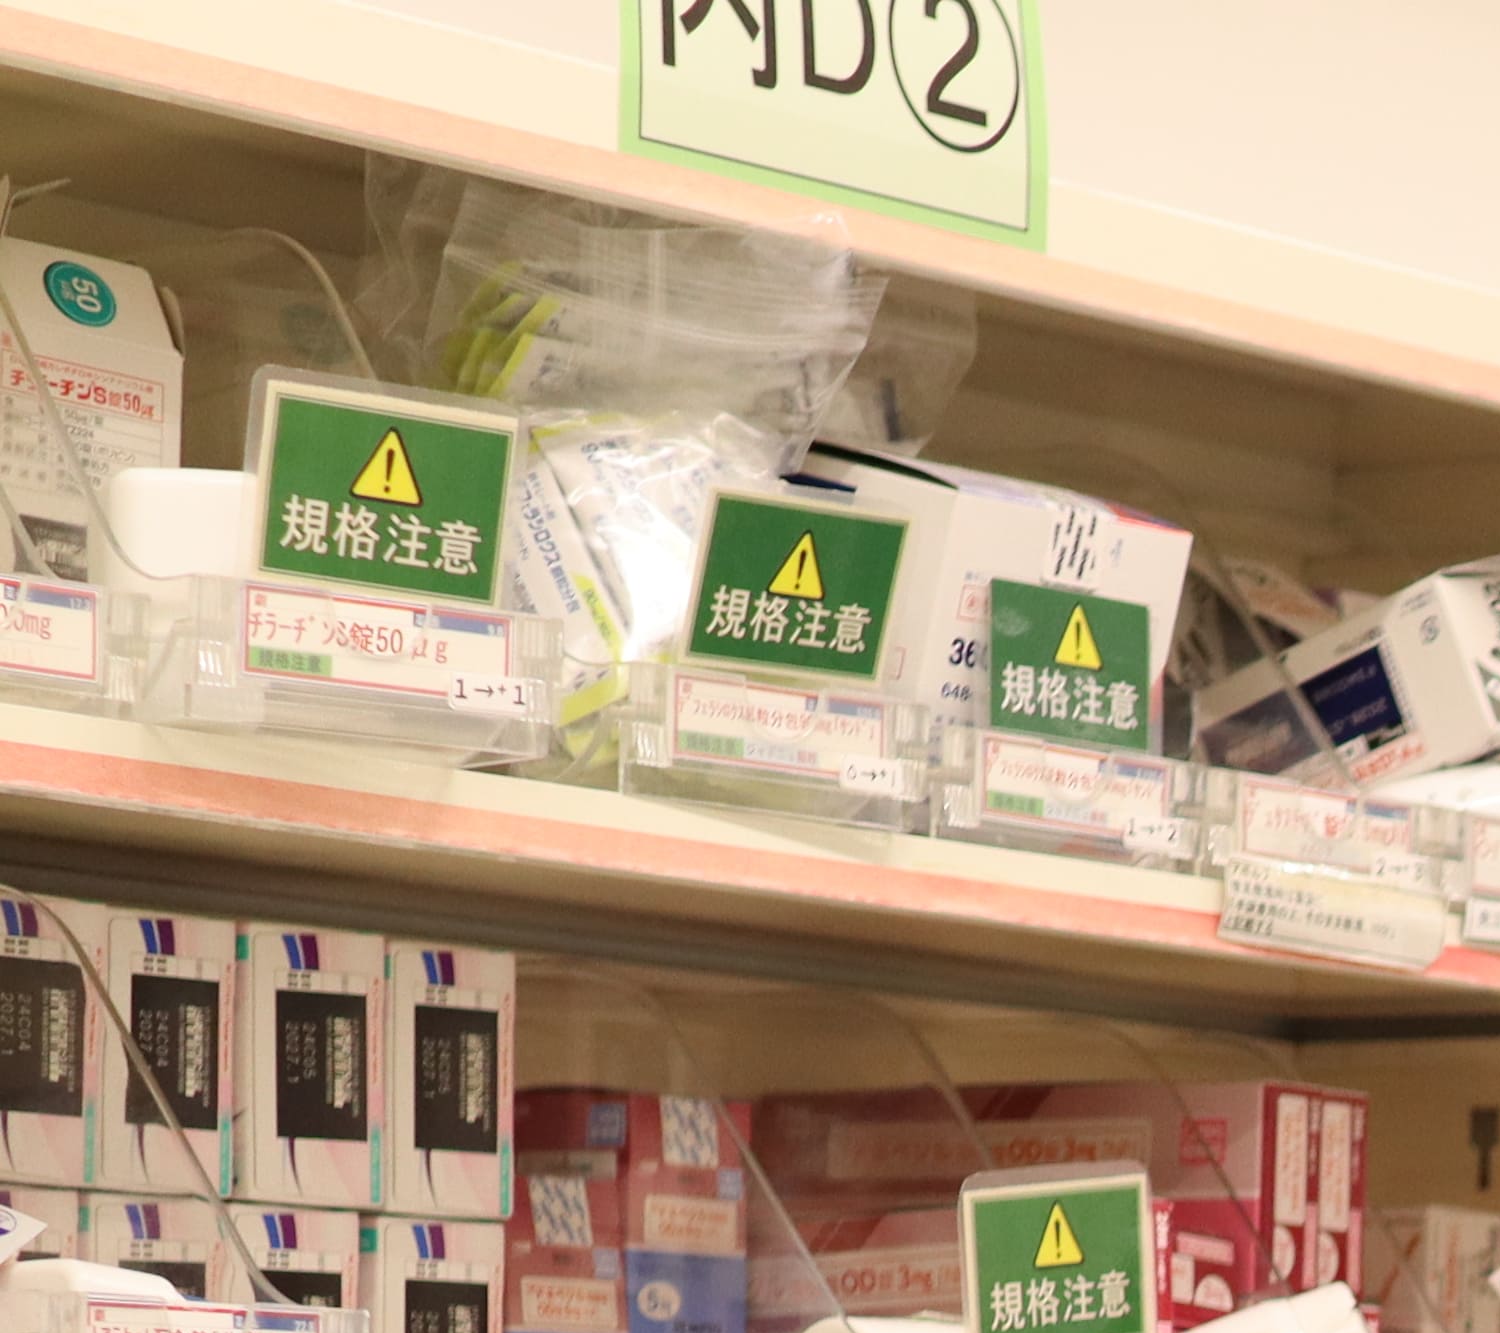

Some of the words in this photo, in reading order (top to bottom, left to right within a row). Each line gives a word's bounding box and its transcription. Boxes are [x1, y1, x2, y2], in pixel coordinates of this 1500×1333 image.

[279, 495, 483, 577] 規格注意
[705, 584, 873, 654] 規格注意
[1000, 661, 1140, 732] 規格注意
[989, 1268, 1132, 1331] 規格注意
